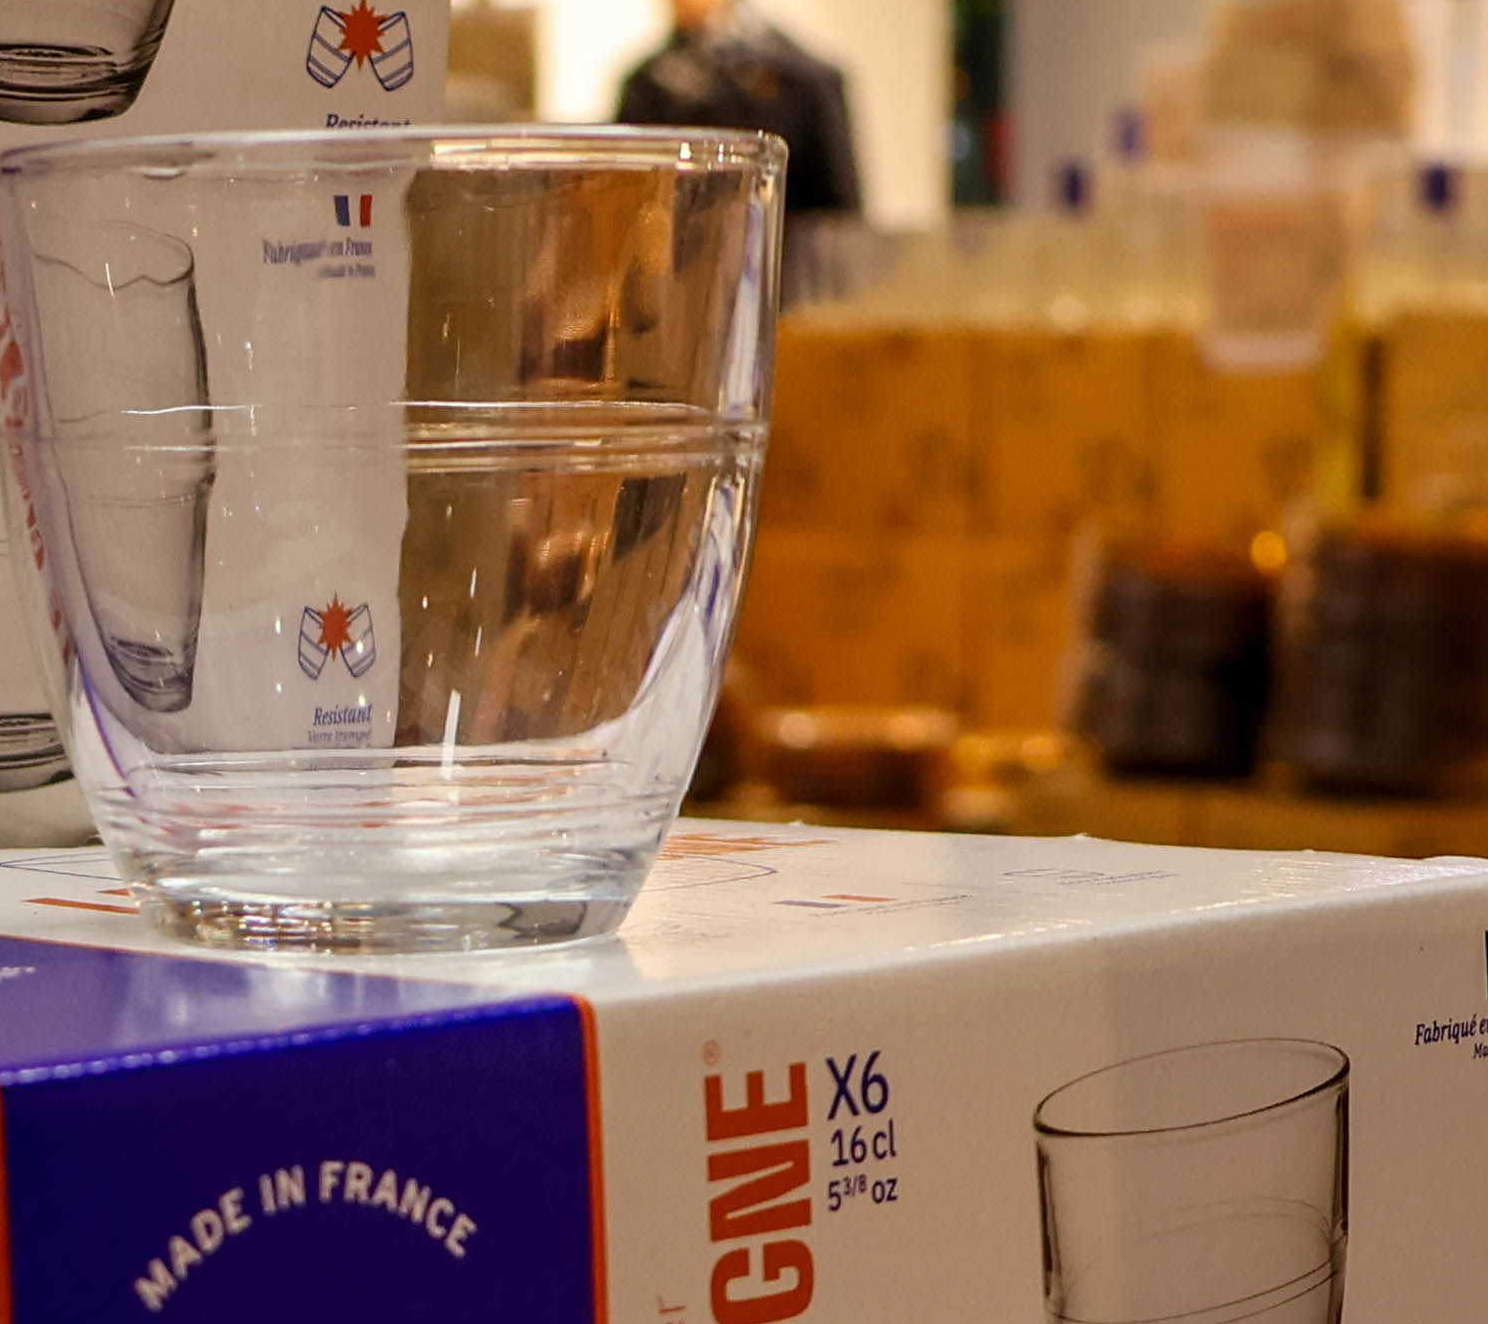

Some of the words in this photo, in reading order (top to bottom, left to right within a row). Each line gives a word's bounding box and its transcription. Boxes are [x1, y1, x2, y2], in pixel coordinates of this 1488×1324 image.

[1414, 1013, 1477, 1045] Fabriqué
[826, 1051, 890, 1122] X6
[134, 1186, 252, 1311] MADE
[259, 1164, 306, 1215] IN
[317, 1160, 478, 1259] FRANCE
